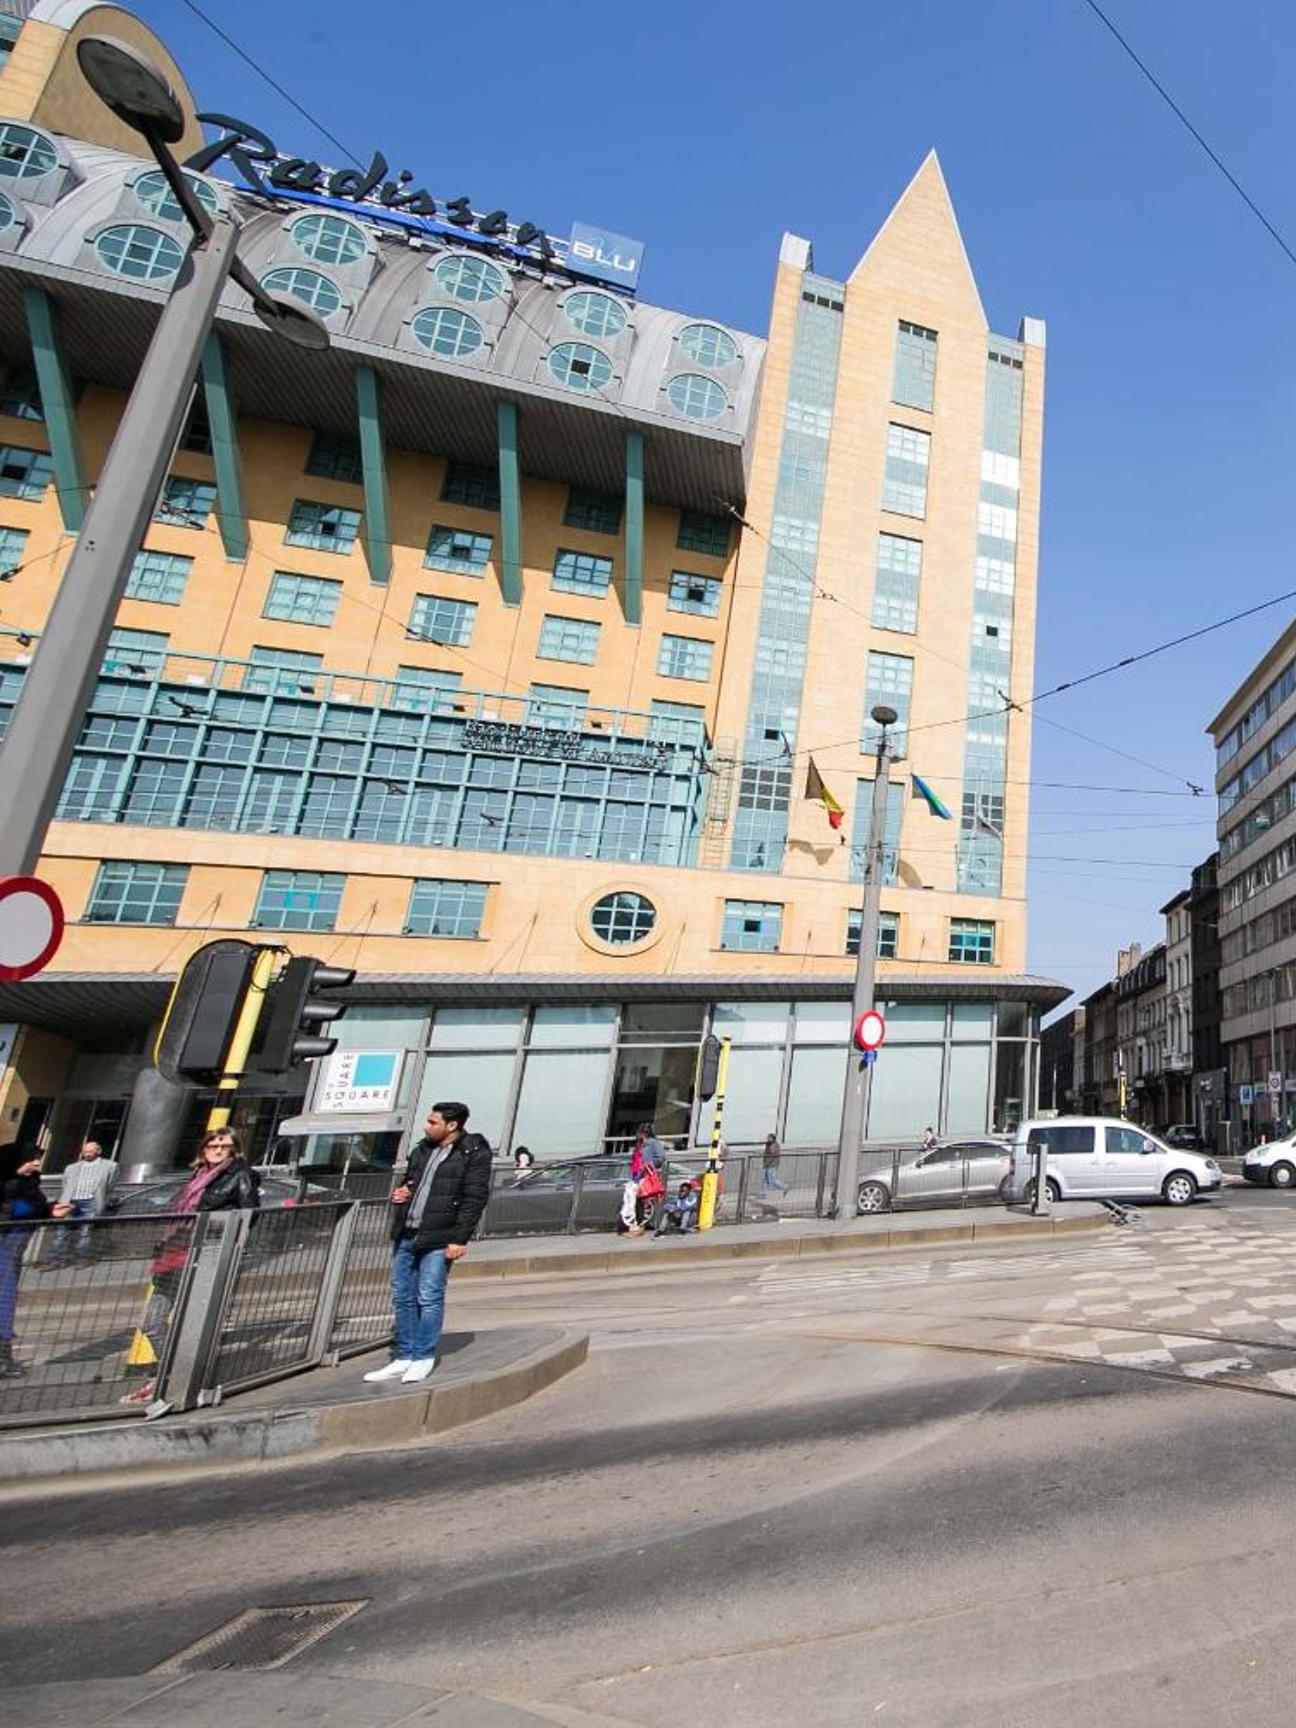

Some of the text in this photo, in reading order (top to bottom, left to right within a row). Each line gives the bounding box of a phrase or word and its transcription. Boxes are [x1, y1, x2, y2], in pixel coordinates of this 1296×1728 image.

[182, 112, 636, 272] Radisson BLU
[325, 1089, 390, 1101] SQUARE
